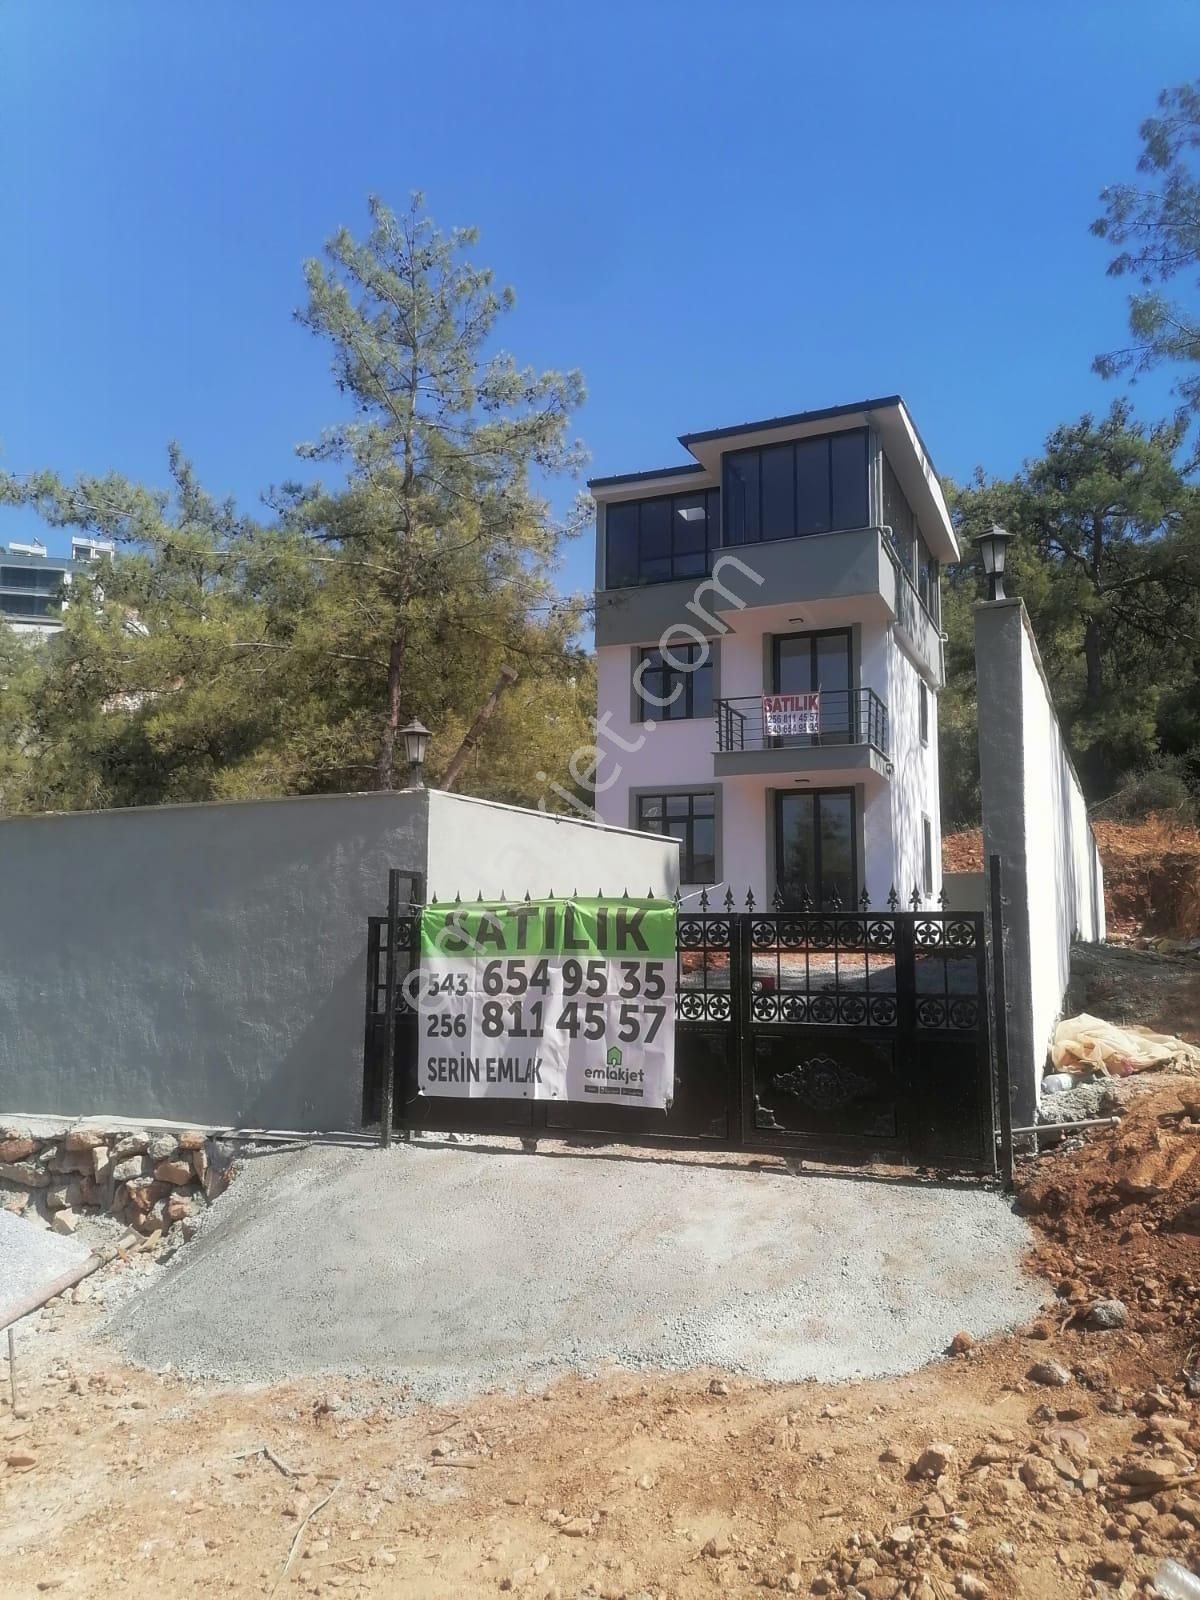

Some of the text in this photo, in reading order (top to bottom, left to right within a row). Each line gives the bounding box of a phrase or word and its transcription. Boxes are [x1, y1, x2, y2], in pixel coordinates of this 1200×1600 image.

[764, 695, 818, 713] SATILIK
[768, 714, 781, 724] 256
[798, 713, 808, 722] 45
[809, 712, 818, 722] 57
[444, 907, 650, 952] SATILIK
[428, 959, 666, 1000] 543 654 95 35
[427, 1001, 667, 1043] 256 811 45 57
[427, 1051, 480, 1083] SERİN
[584, 1066, 645, 1085] emlakjet
